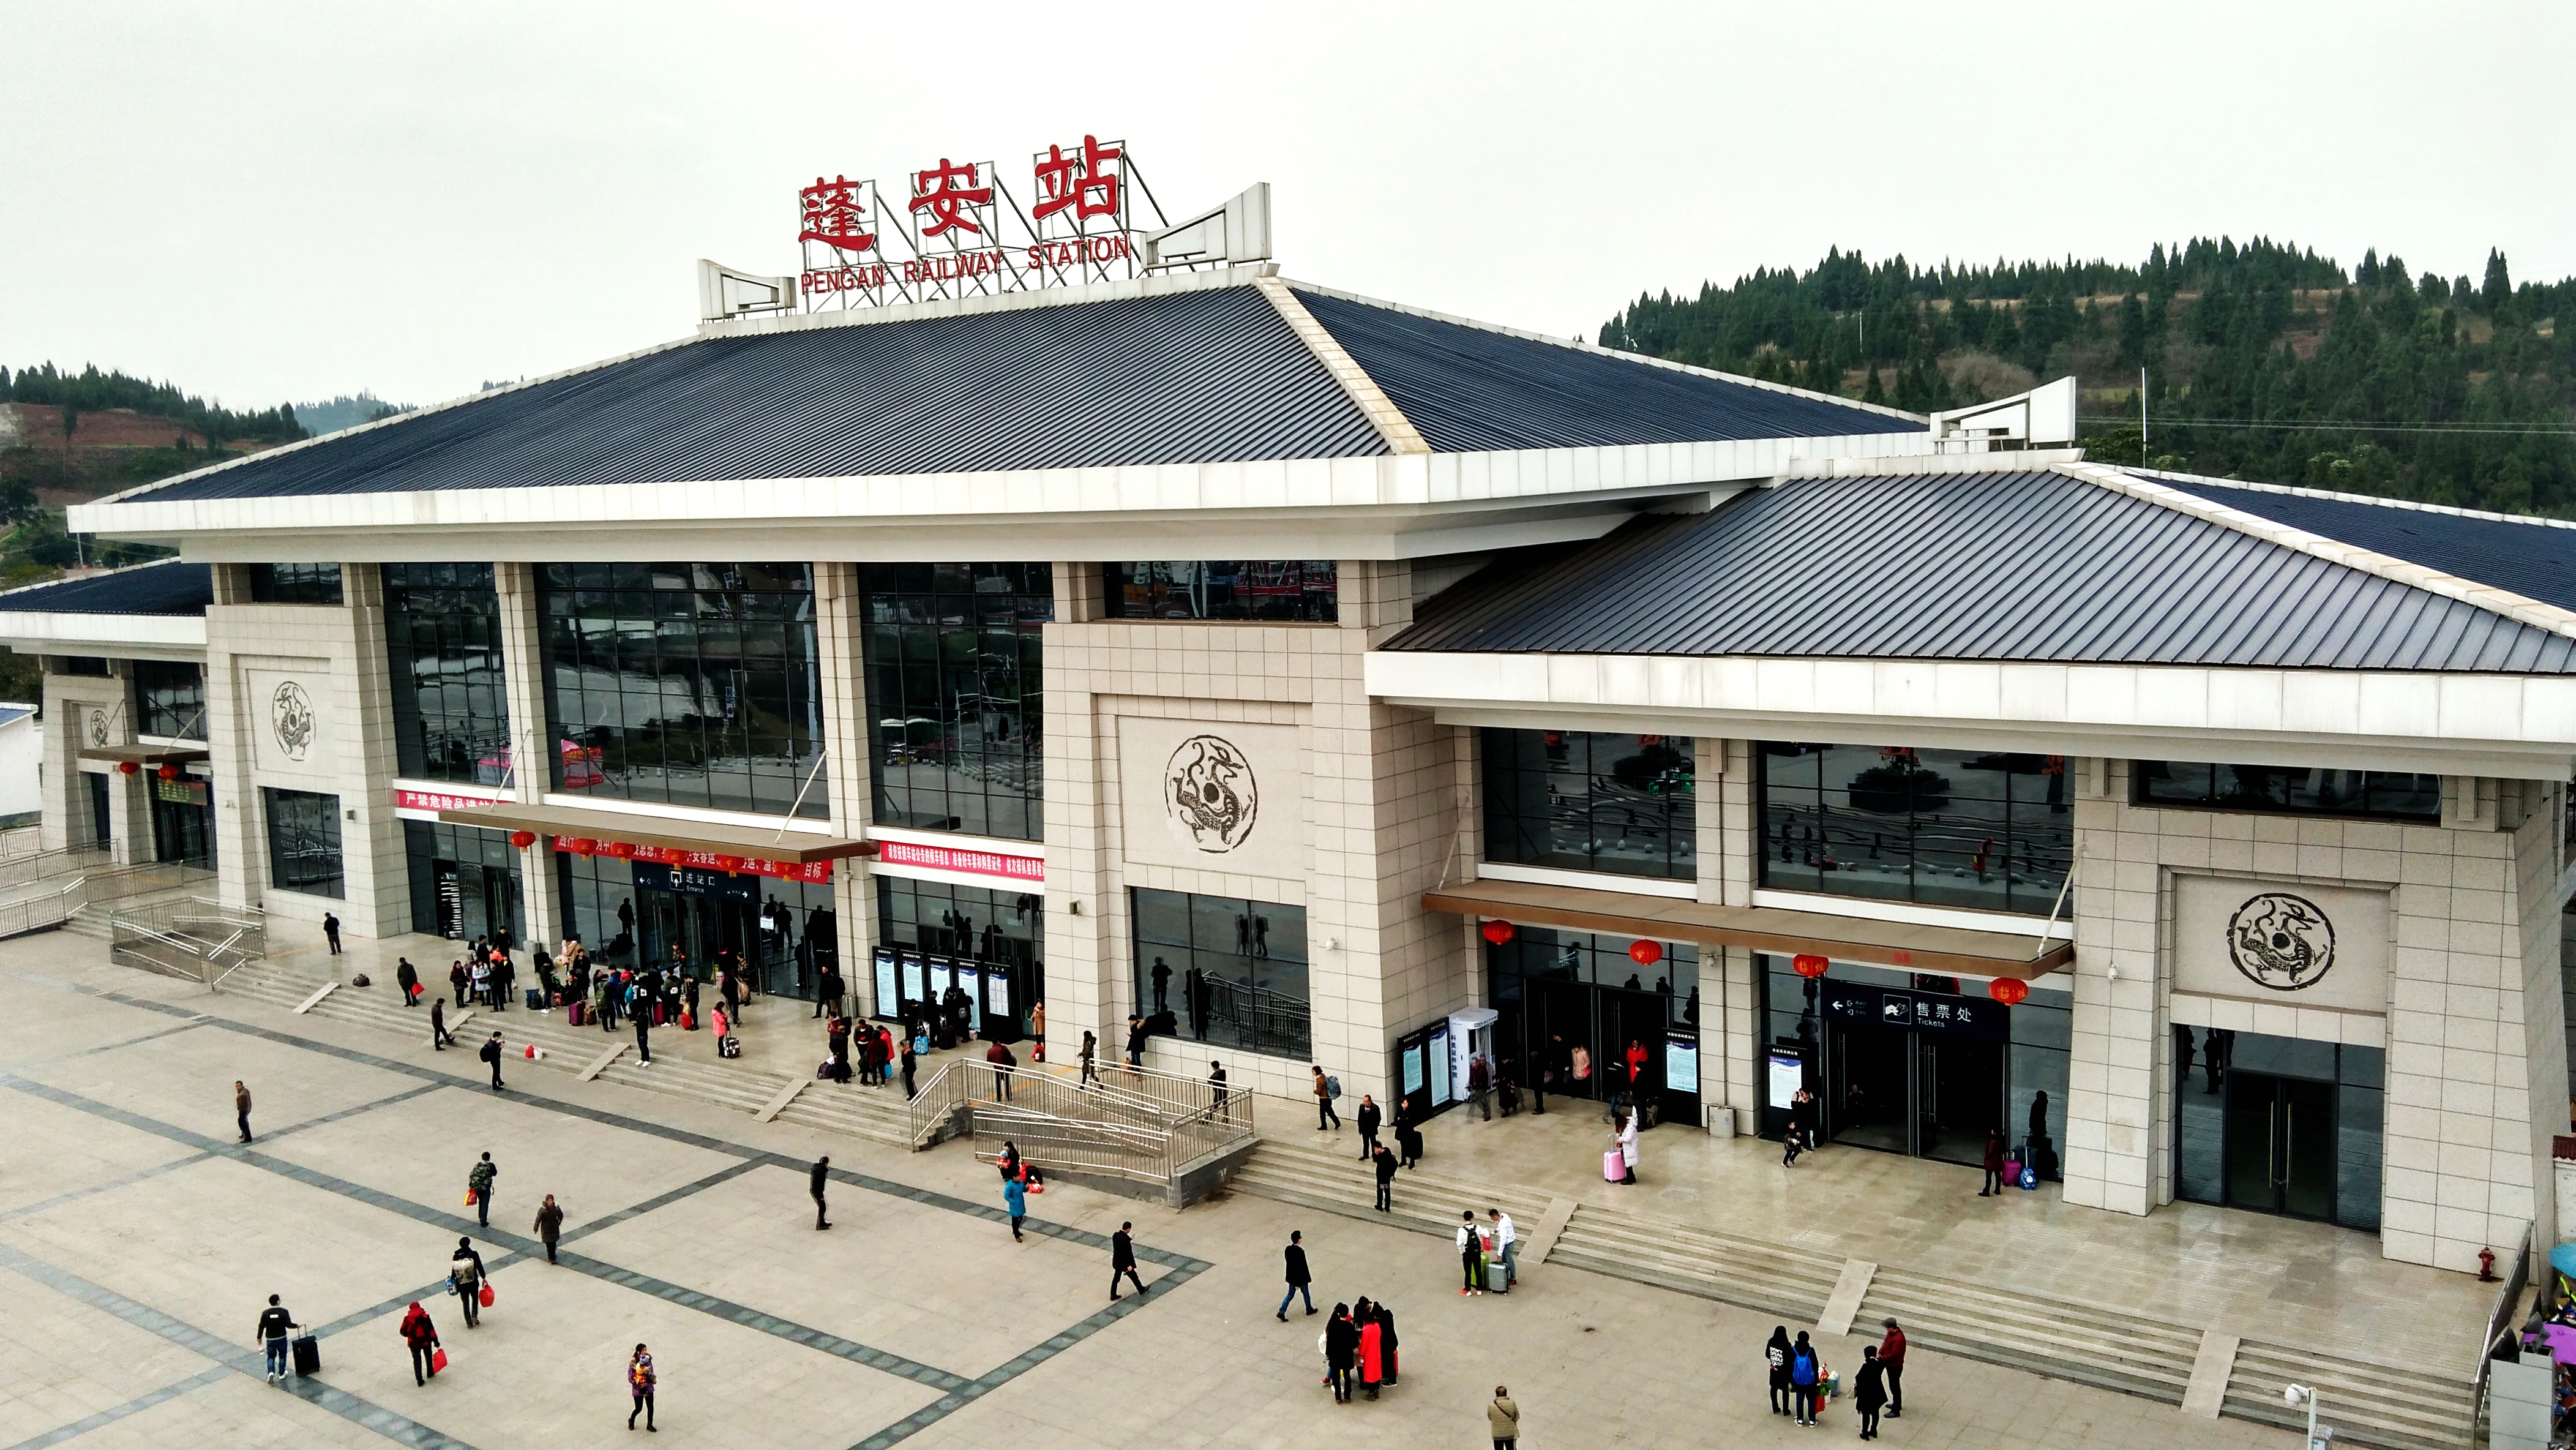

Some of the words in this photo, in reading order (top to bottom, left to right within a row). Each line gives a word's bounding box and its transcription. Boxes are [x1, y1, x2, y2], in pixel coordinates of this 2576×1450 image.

[798, 134, 1123, 252] 蓬安站
[801, 263, 886, 295] PENGAN
[904, 249, 1003, 284] RAILWAY
[1027, 233, 1130, 270] STATION
[888, 844, 949, 866] 请您按照车站公告的候车信息
[952, 851, 1002, 872] 准备好车票和购票证件
[686, 872, 715, 886] 进站口
[1916, 1001, 1971, 1022] 售票处
[1917, 1017, 1945, 1027] Tickets
